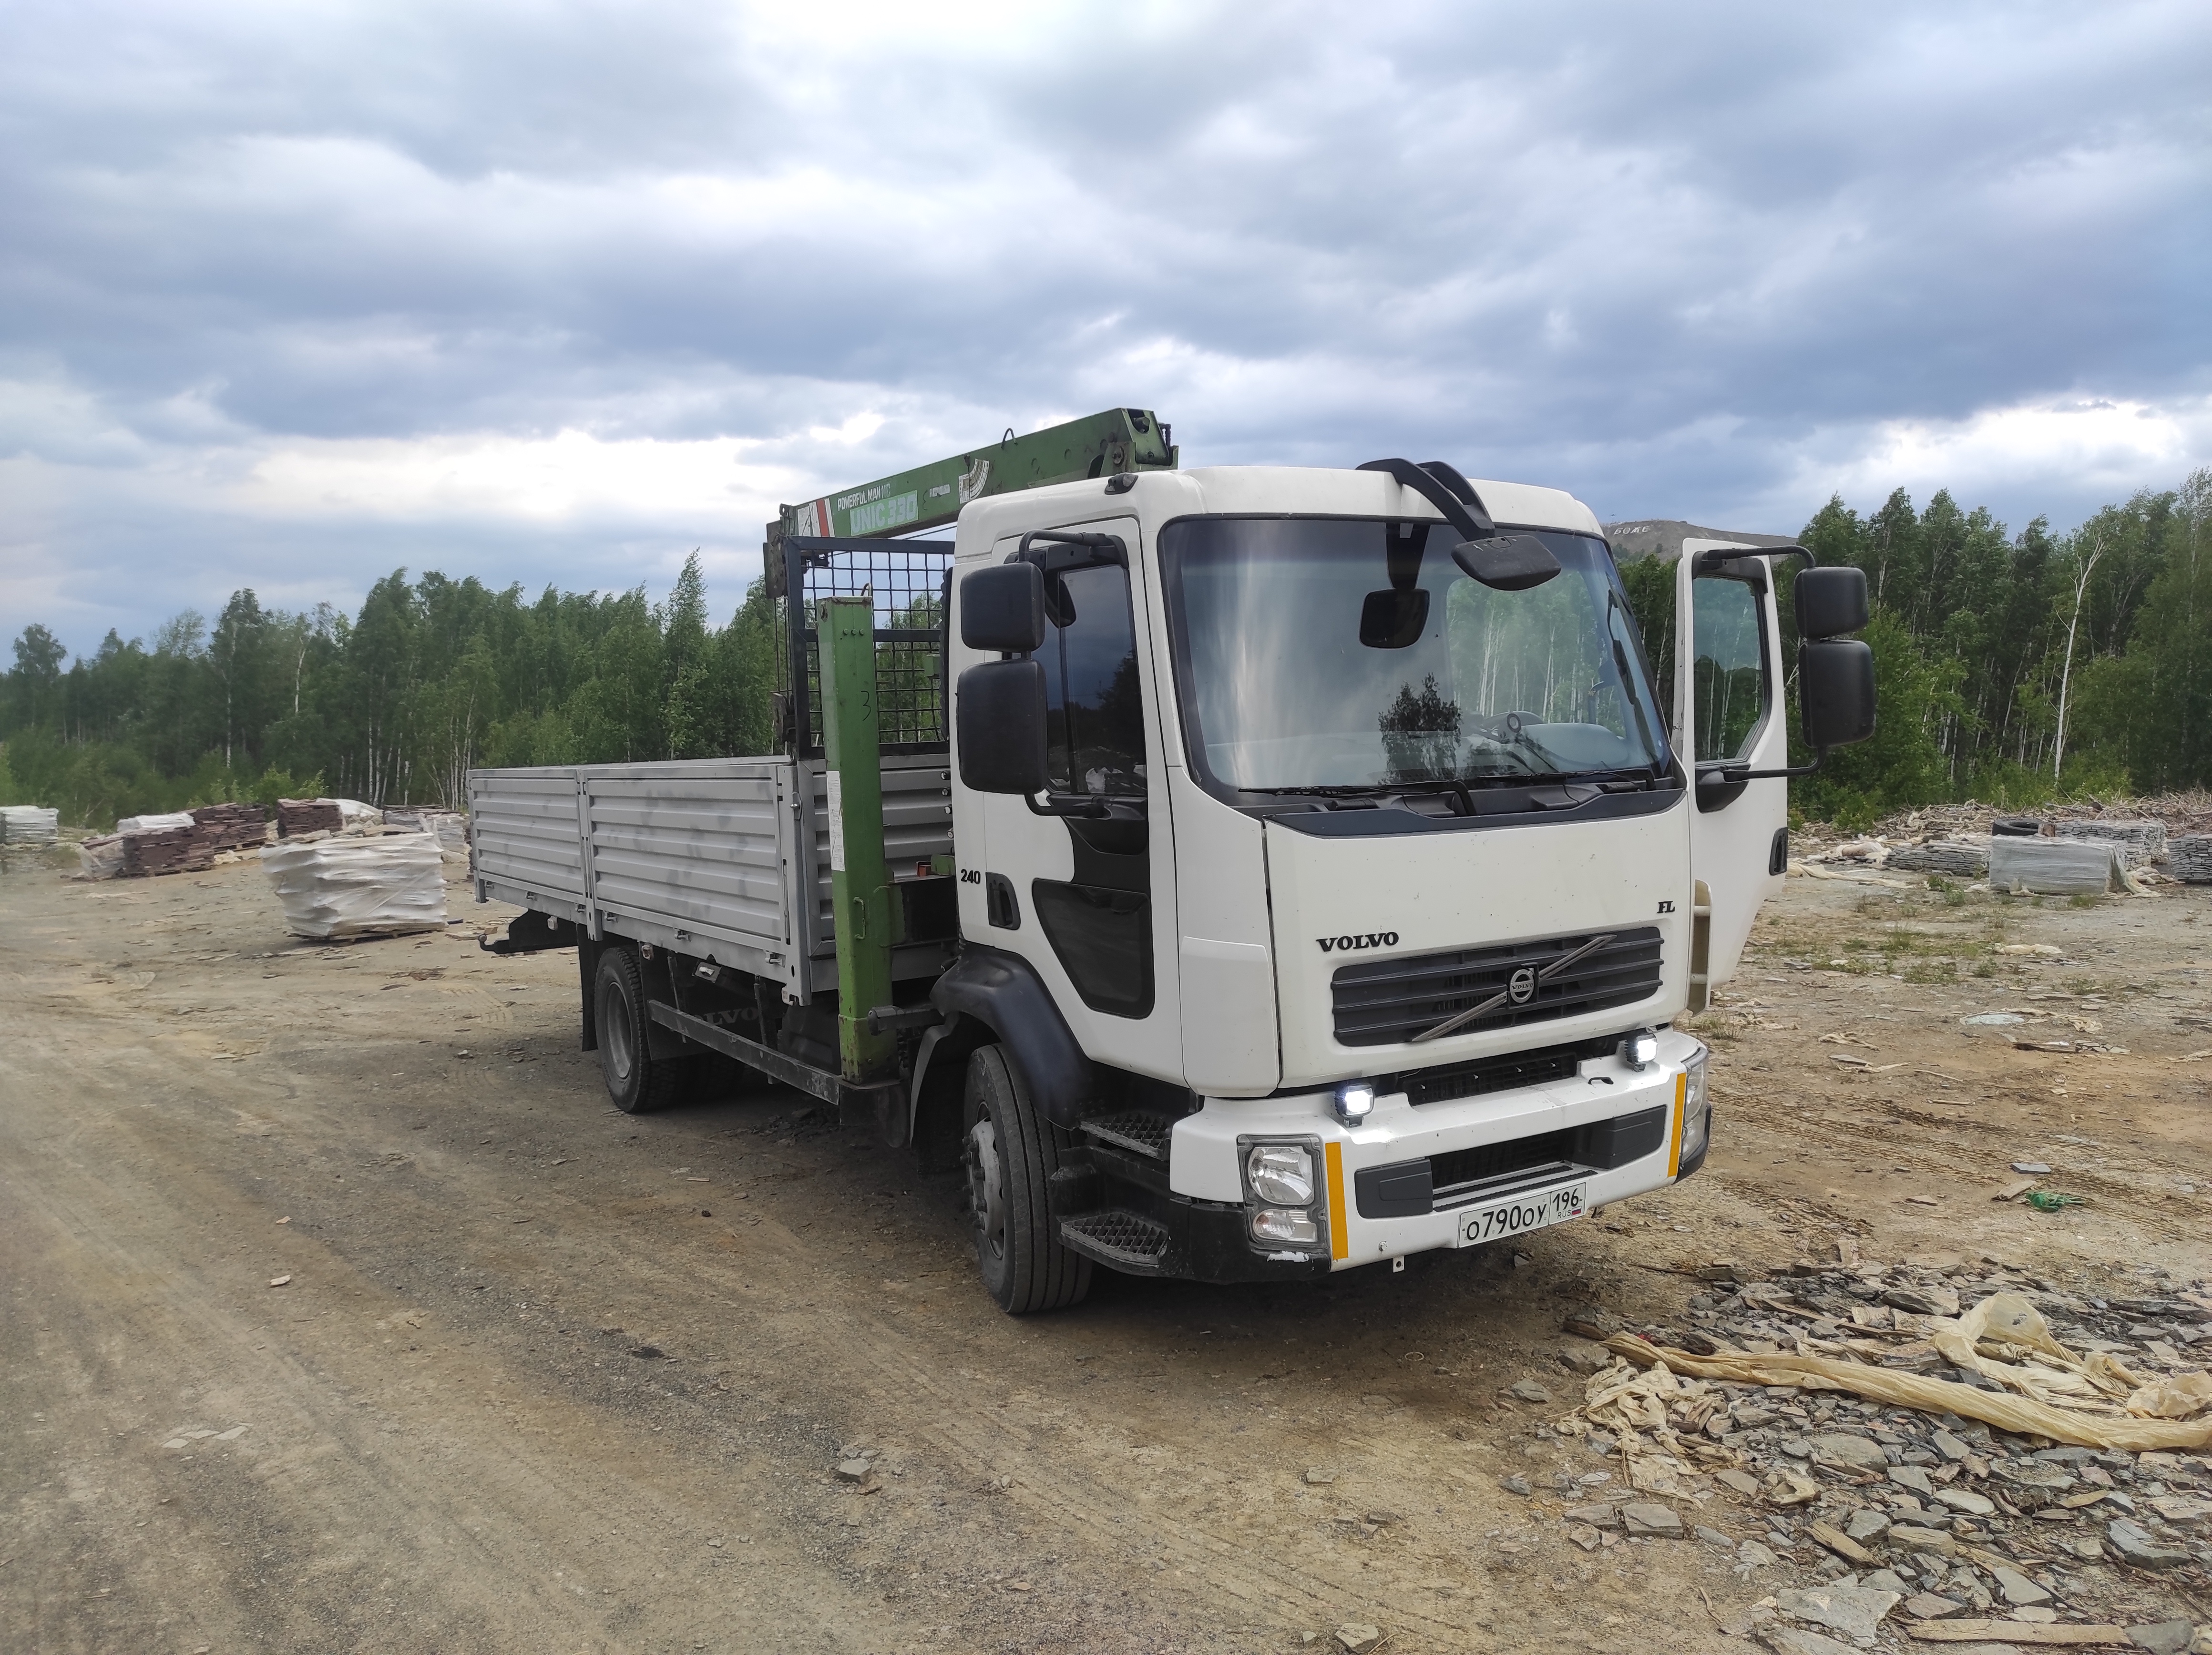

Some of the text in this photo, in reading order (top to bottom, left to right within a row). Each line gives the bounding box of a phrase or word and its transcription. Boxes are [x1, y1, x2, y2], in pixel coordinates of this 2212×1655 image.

[838, 490, 867, 511] POWERFUL
[851, 493, 916, 533] UNIC 330
[1613, 525, 1650, 536] БОЖЕ
[961, 868, 981, 885] 240
[1656, 900, 1676, 914] FL
[1315, 931, 1399, 952] VOLVO
[1552, 1188, 1579, 1211] 196
[1557, 1209, 1571, 1219] RUS
